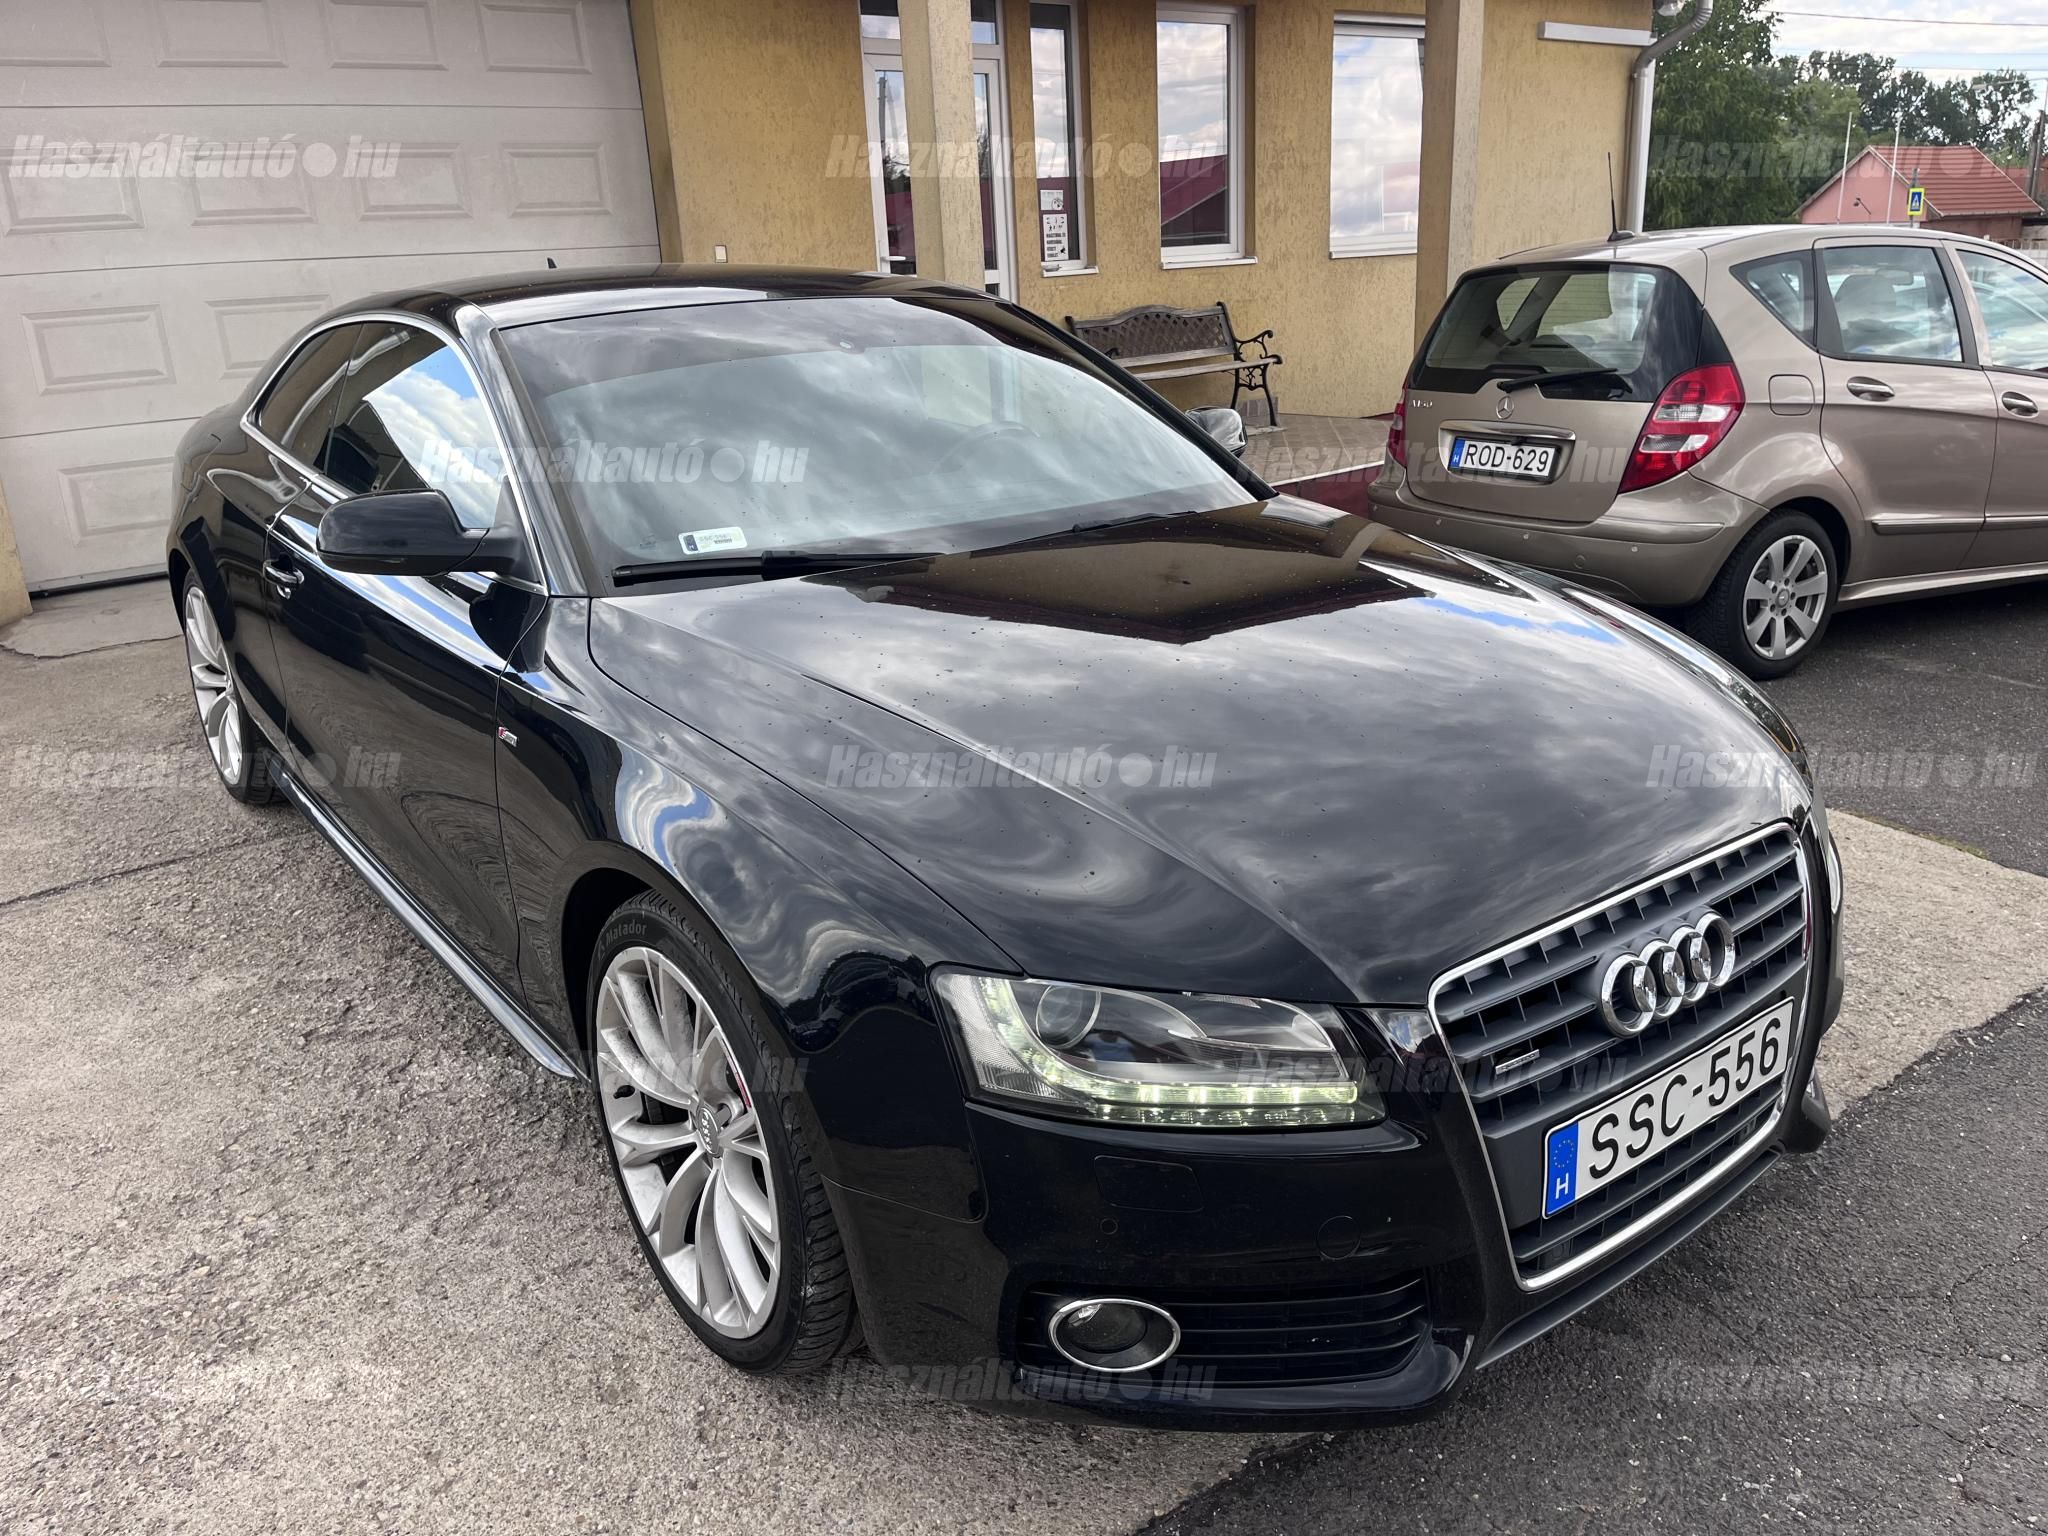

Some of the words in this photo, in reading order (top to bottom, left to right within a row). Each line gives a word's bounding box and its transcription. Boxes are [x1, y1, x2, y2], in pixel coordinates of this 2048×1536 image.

[1463, 443, 1549, 473] ROD-629
[606, 919, 647, 947] Matador
[1588, 1017, 1782, 1180] SSC-556
[1555, 1172, 1569, 1200] H
